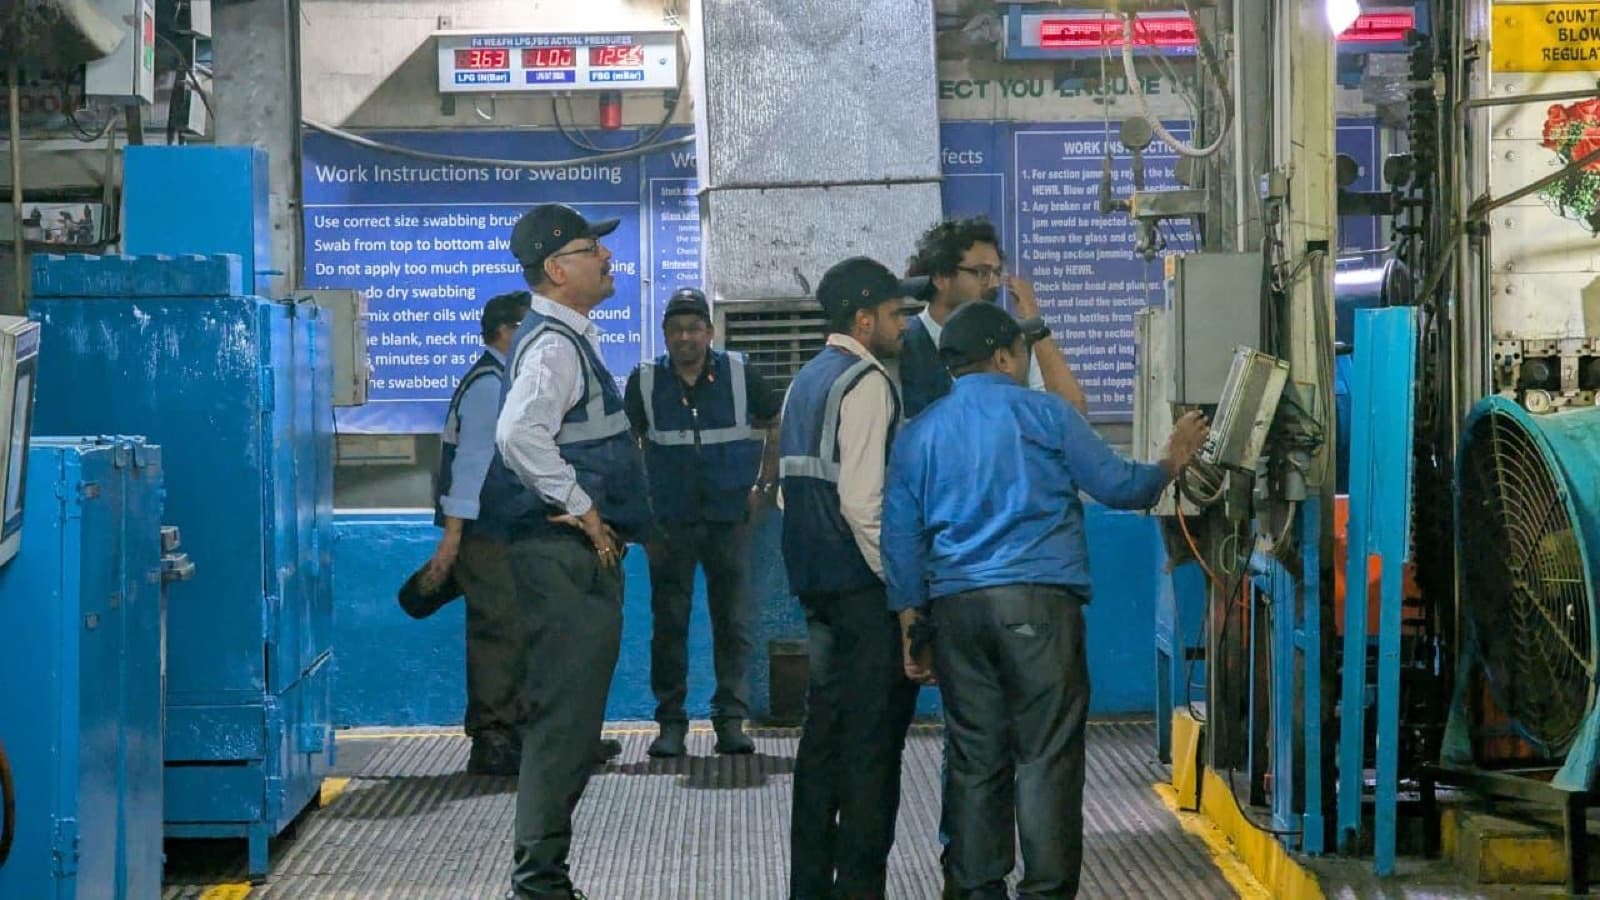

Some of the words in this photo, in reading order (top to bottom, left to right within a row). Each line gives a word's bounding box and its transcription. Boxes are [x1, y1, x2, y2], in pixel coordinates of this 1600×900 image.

[1542, 47, 1600, 61] REGULA
[458, 73, 476, 82] LPG
[939, 80, 990, 99] ECT
[1000, 79, 1044, 98] YOU
[1064, 141, 1101, 155] WORK
[315, 164, 368, 183] Work
[374, 164, 489, 182] Instructions
[495, 167, 522, 182] for
[528, 164, 622, 185] Swabbing
[1022, 169, 1031, 180] 1.
[1032, 169, 1046, 179] For
[1048, 168, 1080, 179] section
[1149, 167, 1163, 178] the
[1063, 184, 1084, 196] Blow
[1086, 183, 1099, 196] off
[1032, 202, 1049, 214] Any
[1051, 201, 1081, 212] broken
[1084, 203, 1092, 212] or
[314, 216, 339, 229] Use
[343, 216, 390, 228] correct
[394, 215, 419, 228] size
[423, 214, 486, 230] swabbing
[1032, 218, 1049, 230] jam
[1051, 217, 1076, 228] would
[1078, 217, 1088, 228] be
[1091, 216, 1127, 229] rejected
[314, 239, 350, 252] Swab
[354, 238, 386, 251] from
[390, 239, 413, 253] top
[417, 239, 430, 251] to
[434, 237, 484, 251] bottom
[487, 236, 511, 251] alw
[1032, 234, 1067, 245] Remove
[1068, 233, 1082, 244] the
[1084, 233, 1108, 246] glass
[1110, 232, 1128, 243] and
[1032, 250, 1061, 262] During
[1063, 249, 1095, 260] section
[1096, 249, 1134, 262] jamming
[315, 263, 335, 275] Do
[338, 263, 360, 275] not
[364, 262, 401, 277] apply
[404, 263, 427, 275] too
[431, 261, 467, 275] much
[472, 263, 524, 276] pressur
[1032, 266, 1051, 276] also
[1053, 265, 1063, 277] by
[367, 286, 383, 298] do
[386, 285, 408, 300] dry
[412, 284, 475, 300] swabbing
[1034, 281, 1059, 292] Check
[1062, 280, 1084, 291] blow
[1108, 279, 1125, 291] and
[1057, 296, 1074, 307] and
[1100, 296, 1111, 306] the
[368, 309, 390, 321] mix
[393, 309, 428, 321] other
[433, 308, 456, 321] oils
[1064, 314, 1077, 323] the
[1080, 313, 1110, 323] bottles
[1112, 312, 1132, 323] from
[382, 331, 422, 346] blank,
[426, 331, 457, 345] neck
[599, 332, 625, 344] nce
[629, 331, 641, 344] in
[1065, 329, 1086, 339] from
[1089, 329, 1102, 338] the
[1107, 344, 1117, 355] of
[375, 351, 430, 365] minutes
[433, 354, 448, 365] or
[451, 354, 466, 365] as
[1083, 361, 1115, 371] section
[1116, 361, 1135, 373] jam
[388, 375, 448, 389] swabbed
[1104, 376, 1133, 389] stoppa
[1103, 392, 1112, 402] to
[1113, 392, 1125, 402] be
